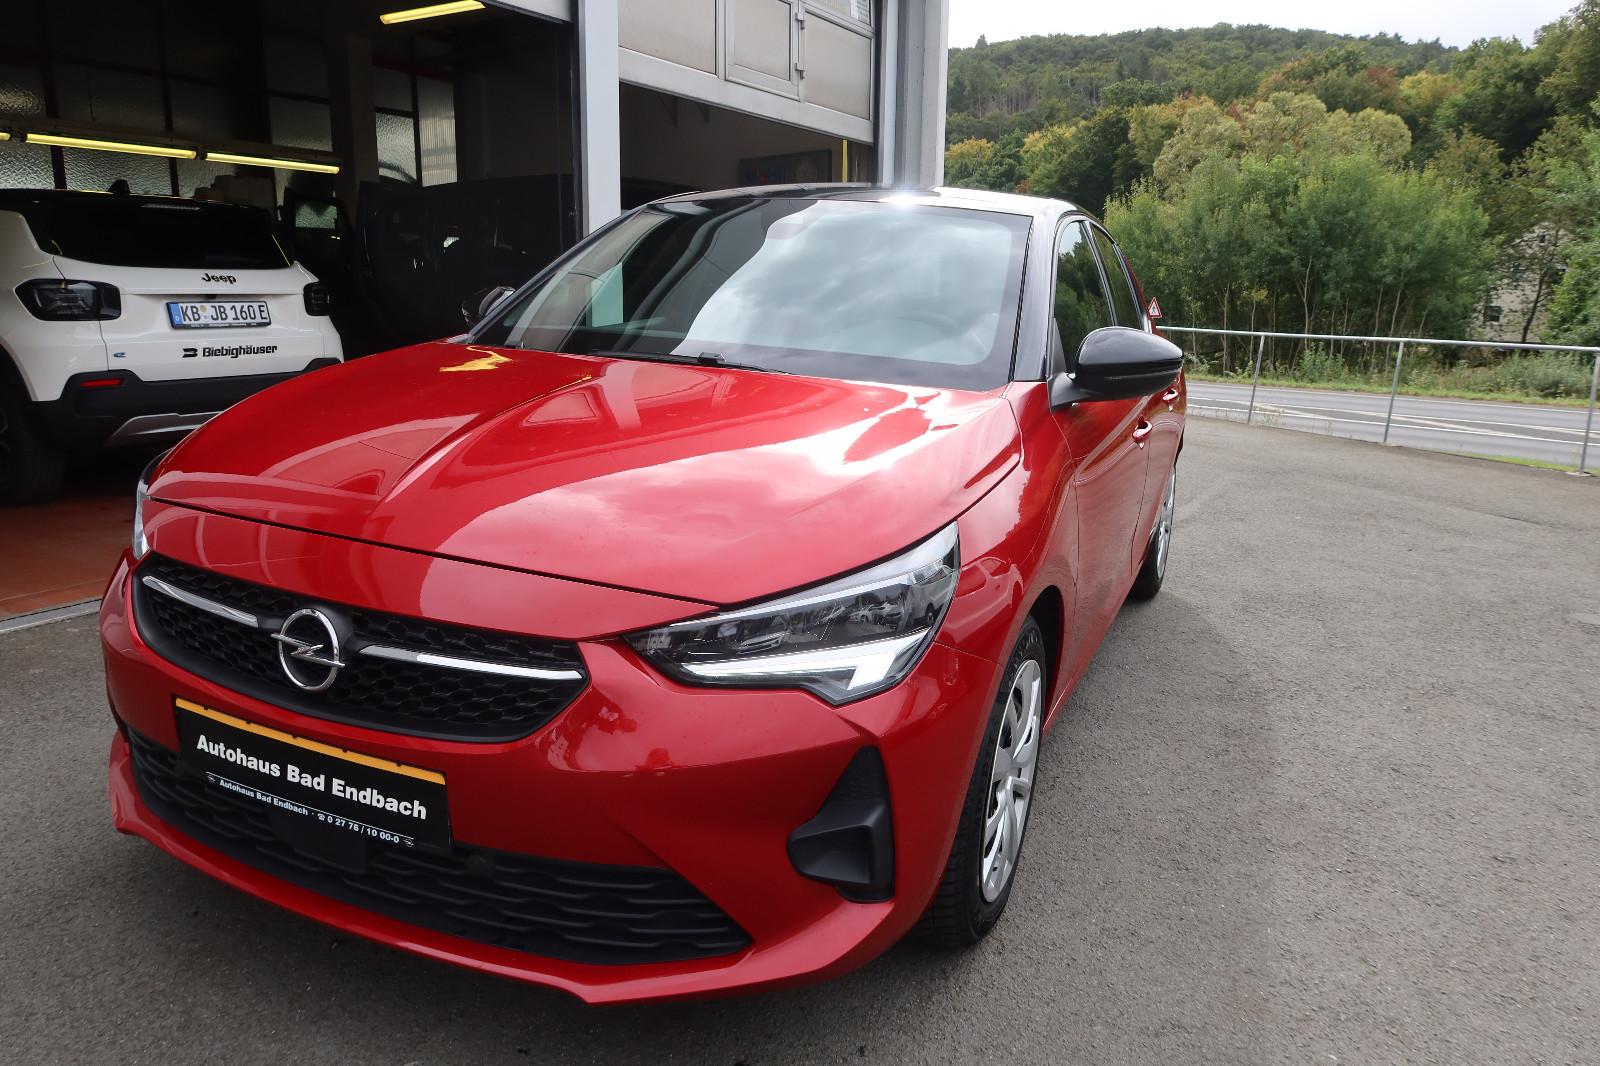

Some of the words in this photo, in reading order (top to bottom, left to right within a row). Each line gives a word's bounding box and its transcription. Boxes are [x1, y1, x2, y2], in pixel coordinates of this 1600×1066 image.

[201, 273, 237, 284] Jeep
[181, 305, 201, 322] KB
[210, 305, 228, 321] JB
[202, 344, 278, 359] Biebighäuser
[196, 734, 281, 777] Autohaus
[287, 764, 325, 791] Bad
[332, 778, 427, 820] Endbach
[219, 780, 254, 798] Autohaus
[256, 792, 271, 803] Bad
[273, 798, 308, 816] Endbach
[335, 818, 346, 827] 27
[348, 822, 359, 831] 76
[366, 828, 378, 837] 10
